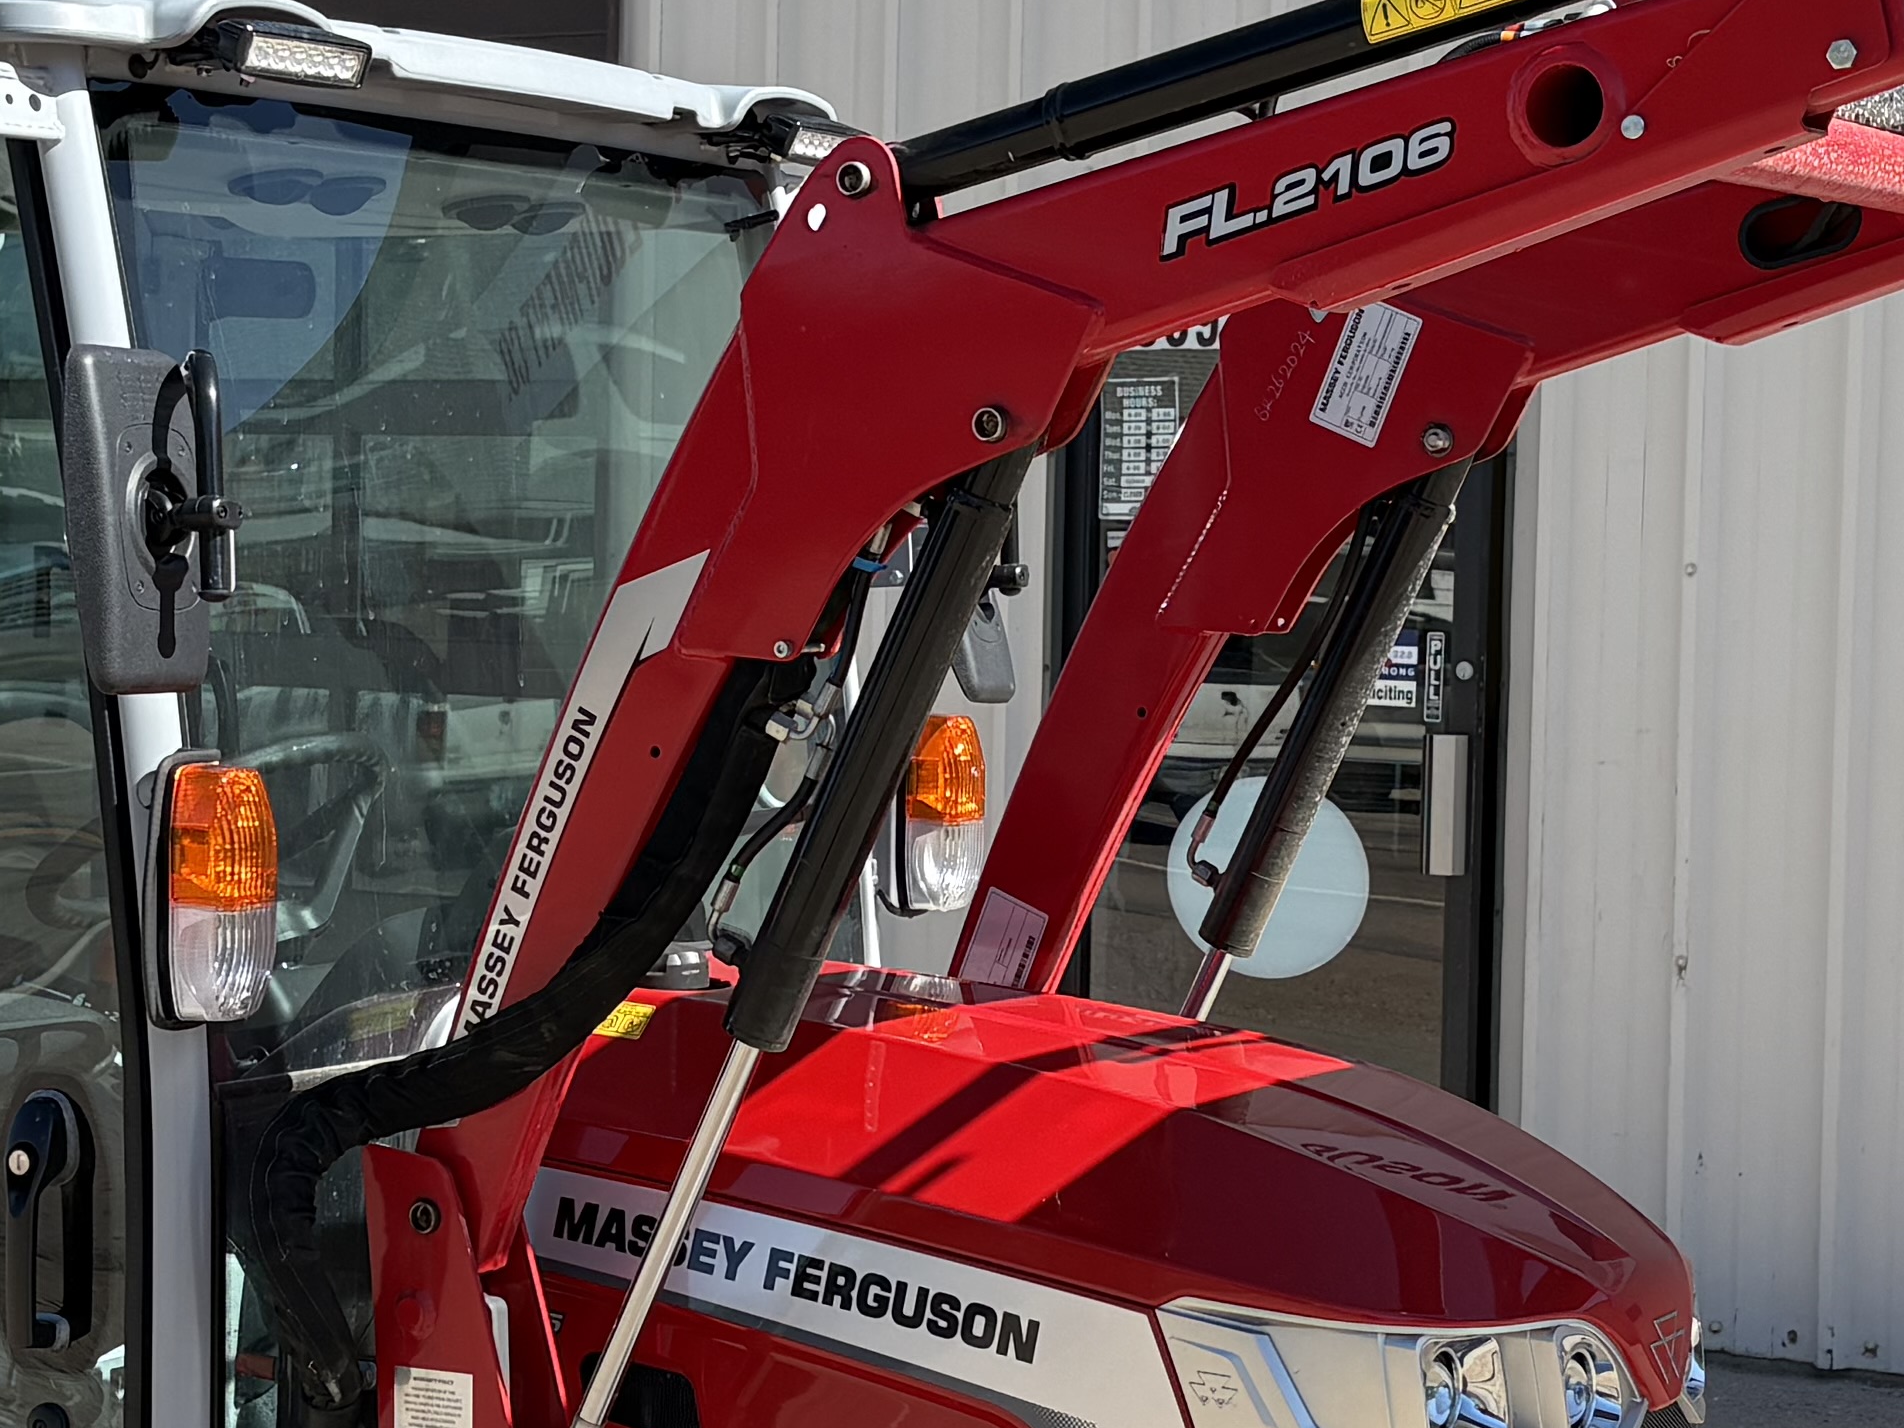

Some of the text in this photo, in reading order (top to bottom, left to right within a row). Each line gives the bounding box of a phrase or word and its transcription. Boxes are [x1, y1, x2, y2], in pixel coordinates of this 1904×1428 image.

[1159, 119, 1455, 260] FL.2106
[1116, 385, 1163, 397] BUSINESS
[1429, 640, 1442, 700] PULL
[511, 705, 598, 900] FERGUSON
[552, 1196, 1041, 1365] MASEY FERGUSON
